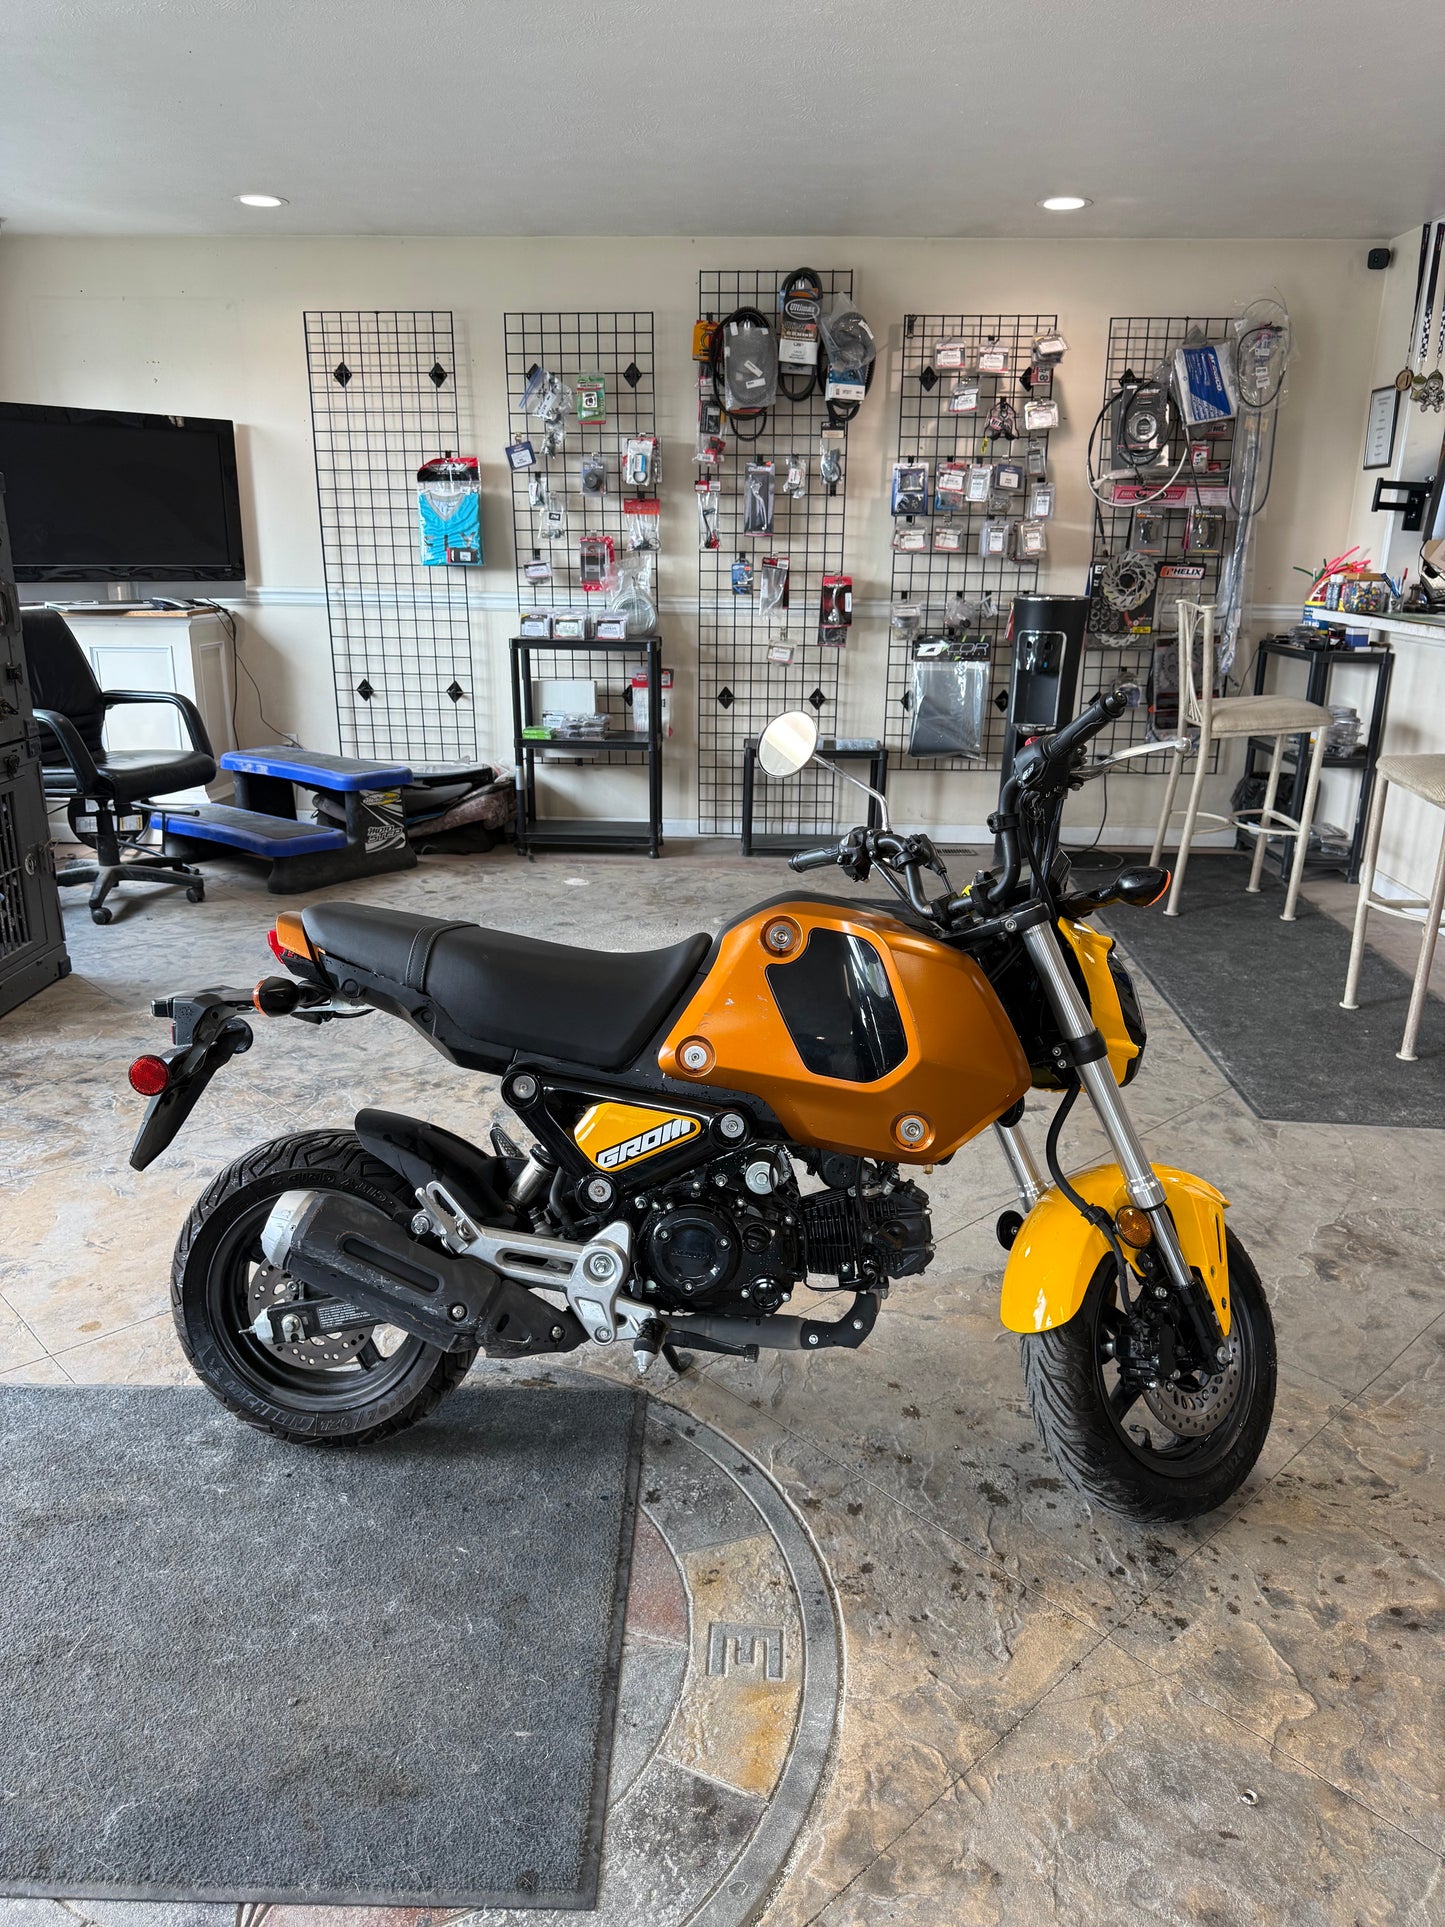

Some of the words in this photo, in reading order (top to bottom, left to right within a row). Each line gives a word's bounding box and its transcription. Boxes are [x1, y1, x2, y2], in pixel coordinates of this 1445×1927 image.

[368, 828, 402, 843] STEP
[597, 1120, 691, 1168] GROM
[707, 1622, 785, 1681] E
